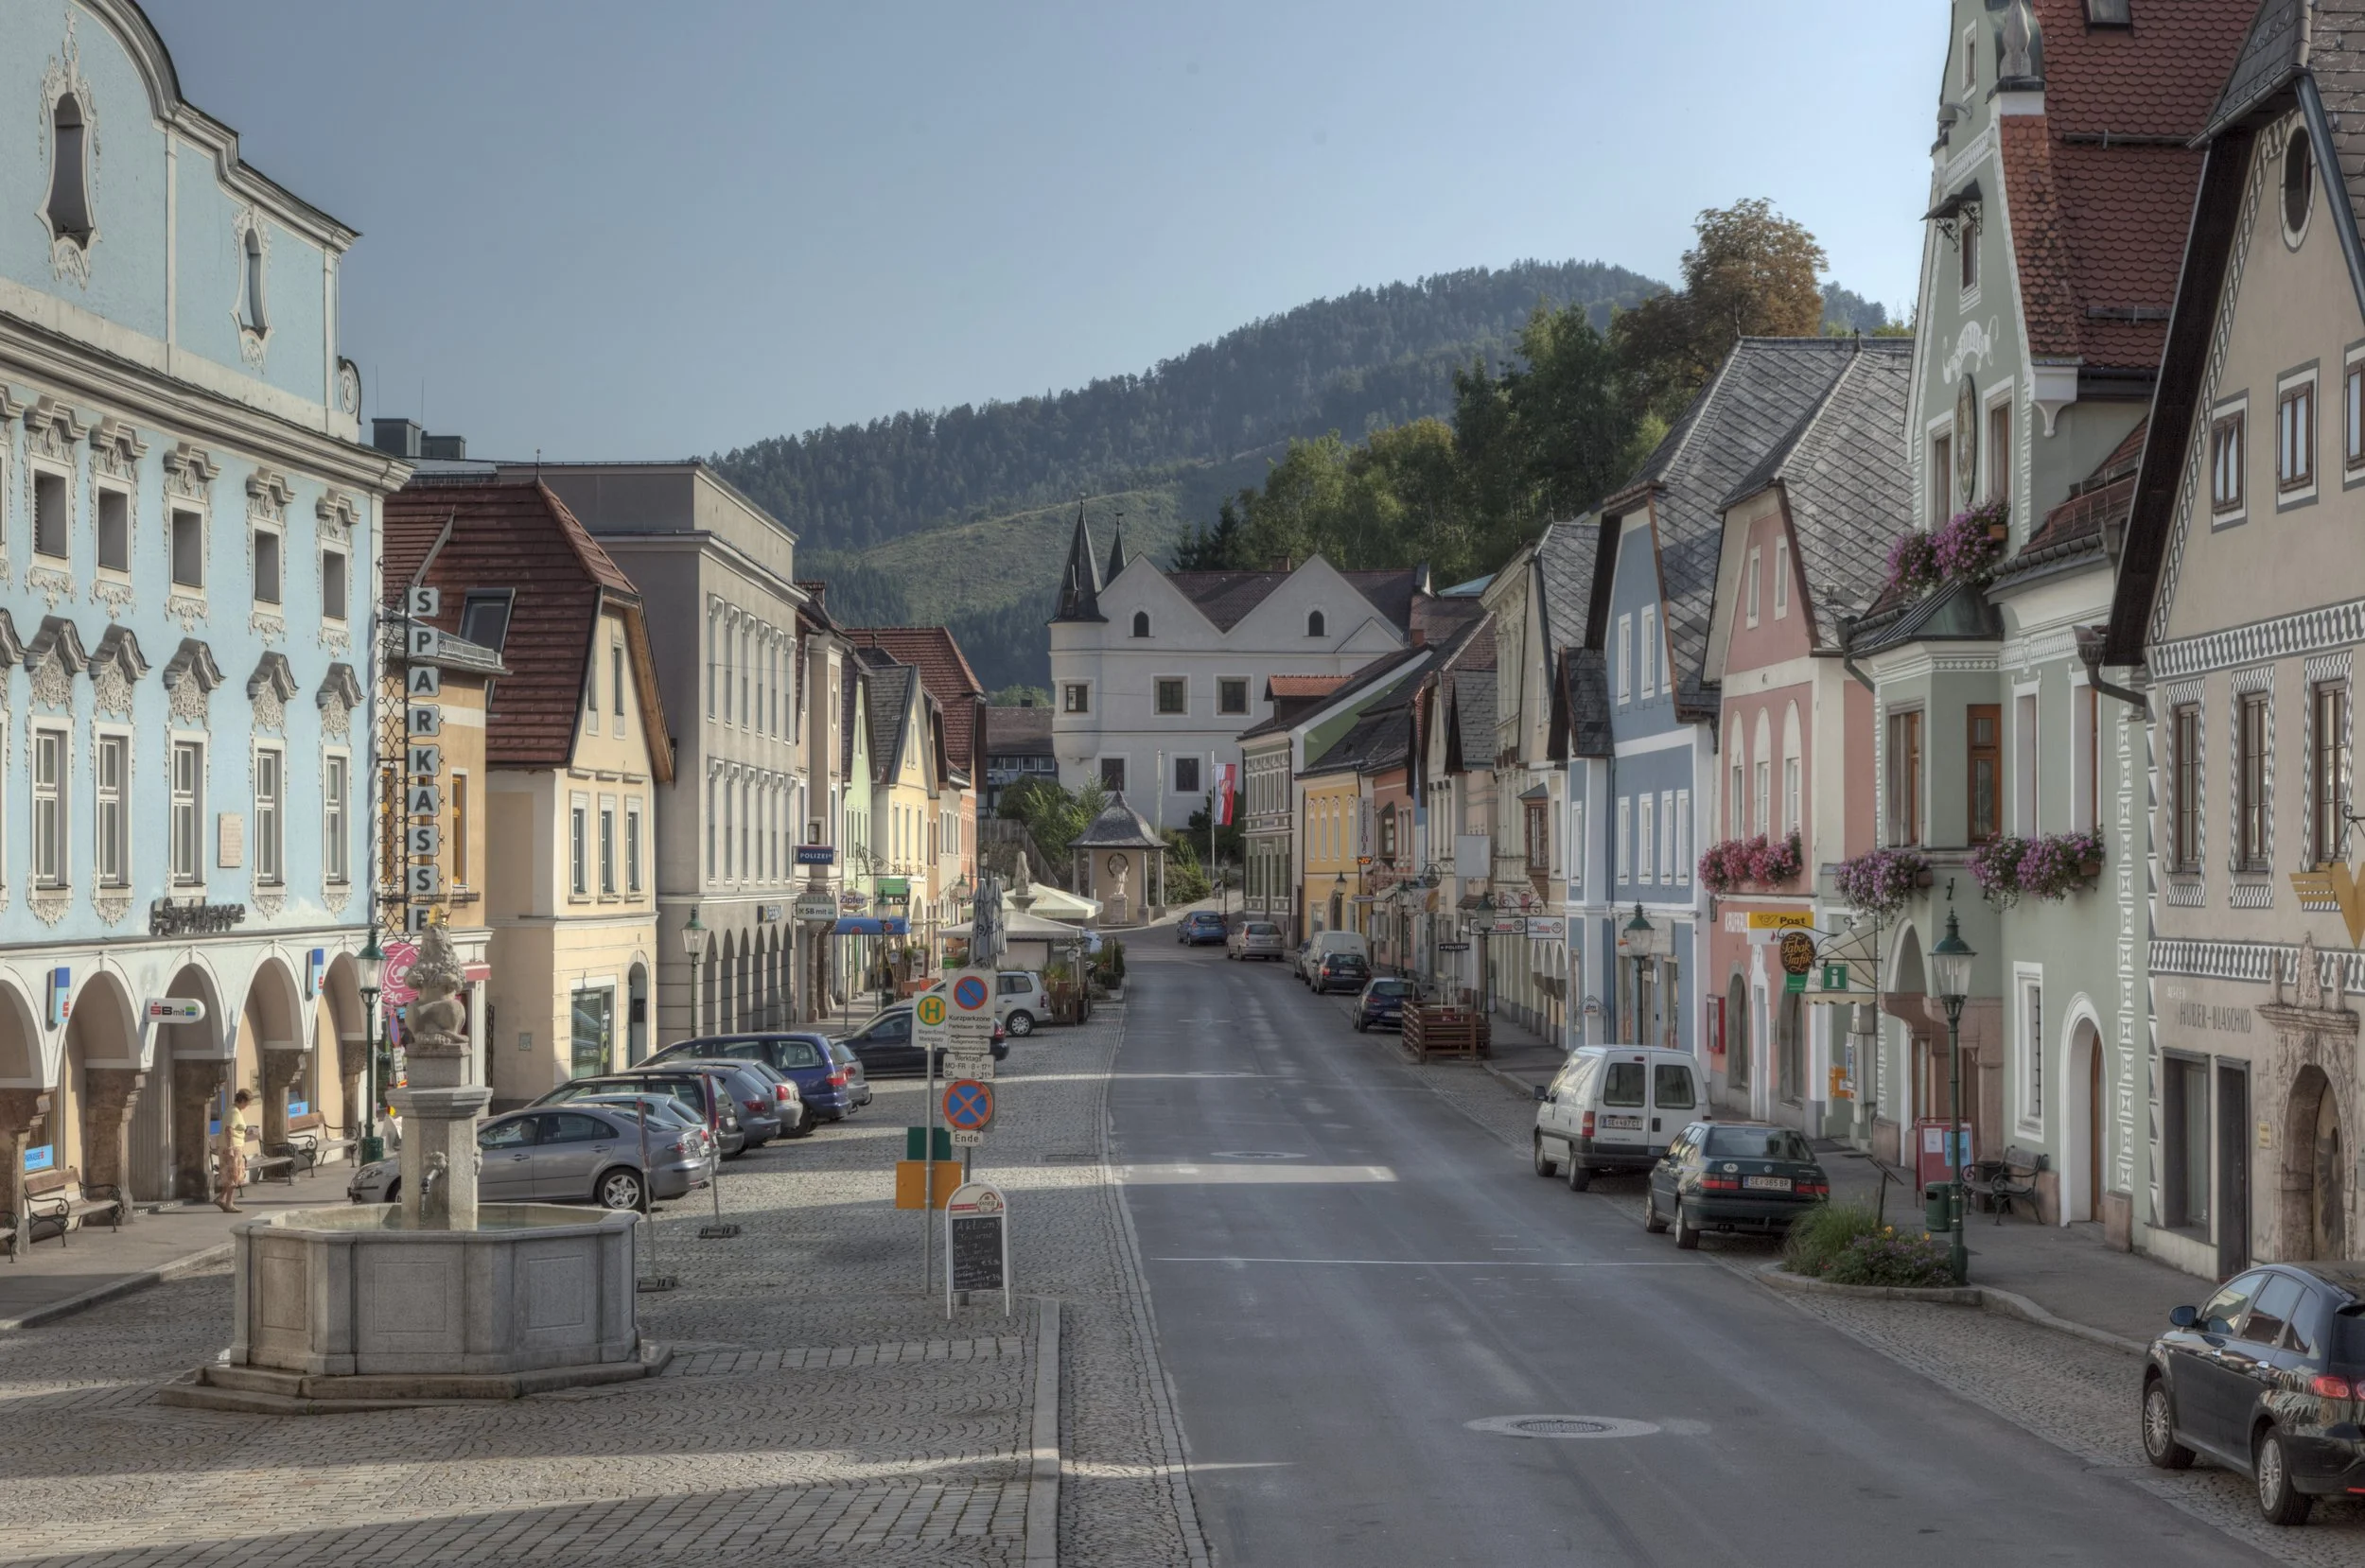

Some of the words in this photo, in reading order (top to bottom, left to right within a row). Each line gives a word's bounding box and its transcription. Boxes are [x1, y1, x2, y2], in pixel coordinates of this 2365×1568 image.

[413, 591, 434, 932] SPARKASSE
[840, 895, 865, 905] Zipfer
[1779, 916, 1806, 925] Post
[1782, 934, 1811, 954] Tabak
[1785, 952, 1813, 973] Trafik
[173, 1008, 185, 1017] mit
[949, 1014, 991, 1022] Kurzparkzone
[2180, 1002, 2251, 1034] HUBER-BLASCHKO
[955, 1134, 979, 1142] Ende
